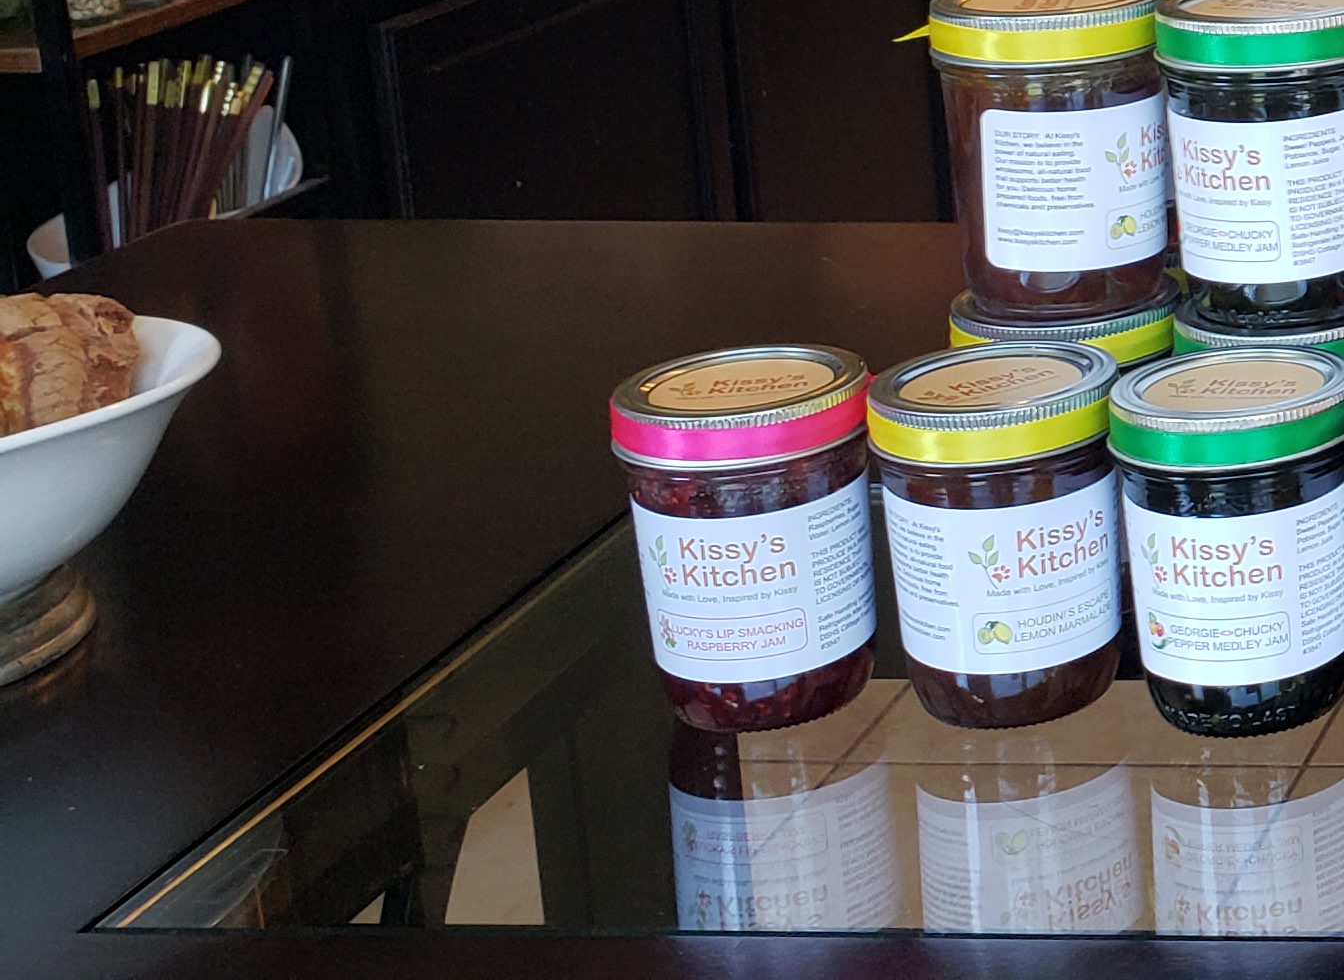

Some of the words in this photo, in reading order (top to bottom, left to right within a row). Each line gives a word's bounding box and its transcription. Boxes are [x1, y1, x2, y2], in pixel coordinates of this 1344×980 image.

[1181, 137, 1261, 171] Kissy's
[1183, 163, 1271, 191] Kitchen
[1212, 241, 1252, 251] MEDLEY
[1254, 243, 1278, 251] JAM
[1228, 230, 1273, 239] CHUCKY
[707, 381, 809, 395] Kitchen
[712, 373, 806, 388] Kissy's
[958, 369, 1055, 397] Kitchen
[1200, 387, 1297, 395] Kitchen
[1209, 379, 1297, 388] Kissy's
[1017, 509, 1104, 552] Kissy's
[679, 533, 786, 564] Kissy's
[1018, 533, 1109, 579] Kitchen
[1171, 535, 1274, 565] Kissy's
[682, 561, 797, 587] Kitchen
[986, 588, 1011, 598] Made
[1014, 586, 1031, 595] with
[1058, 571, 1087, 587] Inspired
[1088, 568, 1096, 577] by
[1173, 563, 1283, 588] Kitchen
[1017, 607, 1075, 629] HOUDINI'S
[1077, 589, 1110, 614] ESCAPE
[671, 624, 714, 638] LUCKY'S
[717, 628, 735, 639] LIP
[737, 618, 804, 637] SMACKING
[1014, 629, 1056, 644] LEMON
[1058, 602, 1112, 634] MARMALADE
[1170, 625, 1220, 637] GEORGIE
[1234, 621, 1284, 637] CHUCKY
[687, 640, 757, 652] RASPBERRY
[761, 636, 786, 648] JAM
[1168, 636, 1210, 651] PEPPER
[1212, 638, 1261, 652] MEDLEY
[1265, 634, 1289, 646] JAM
